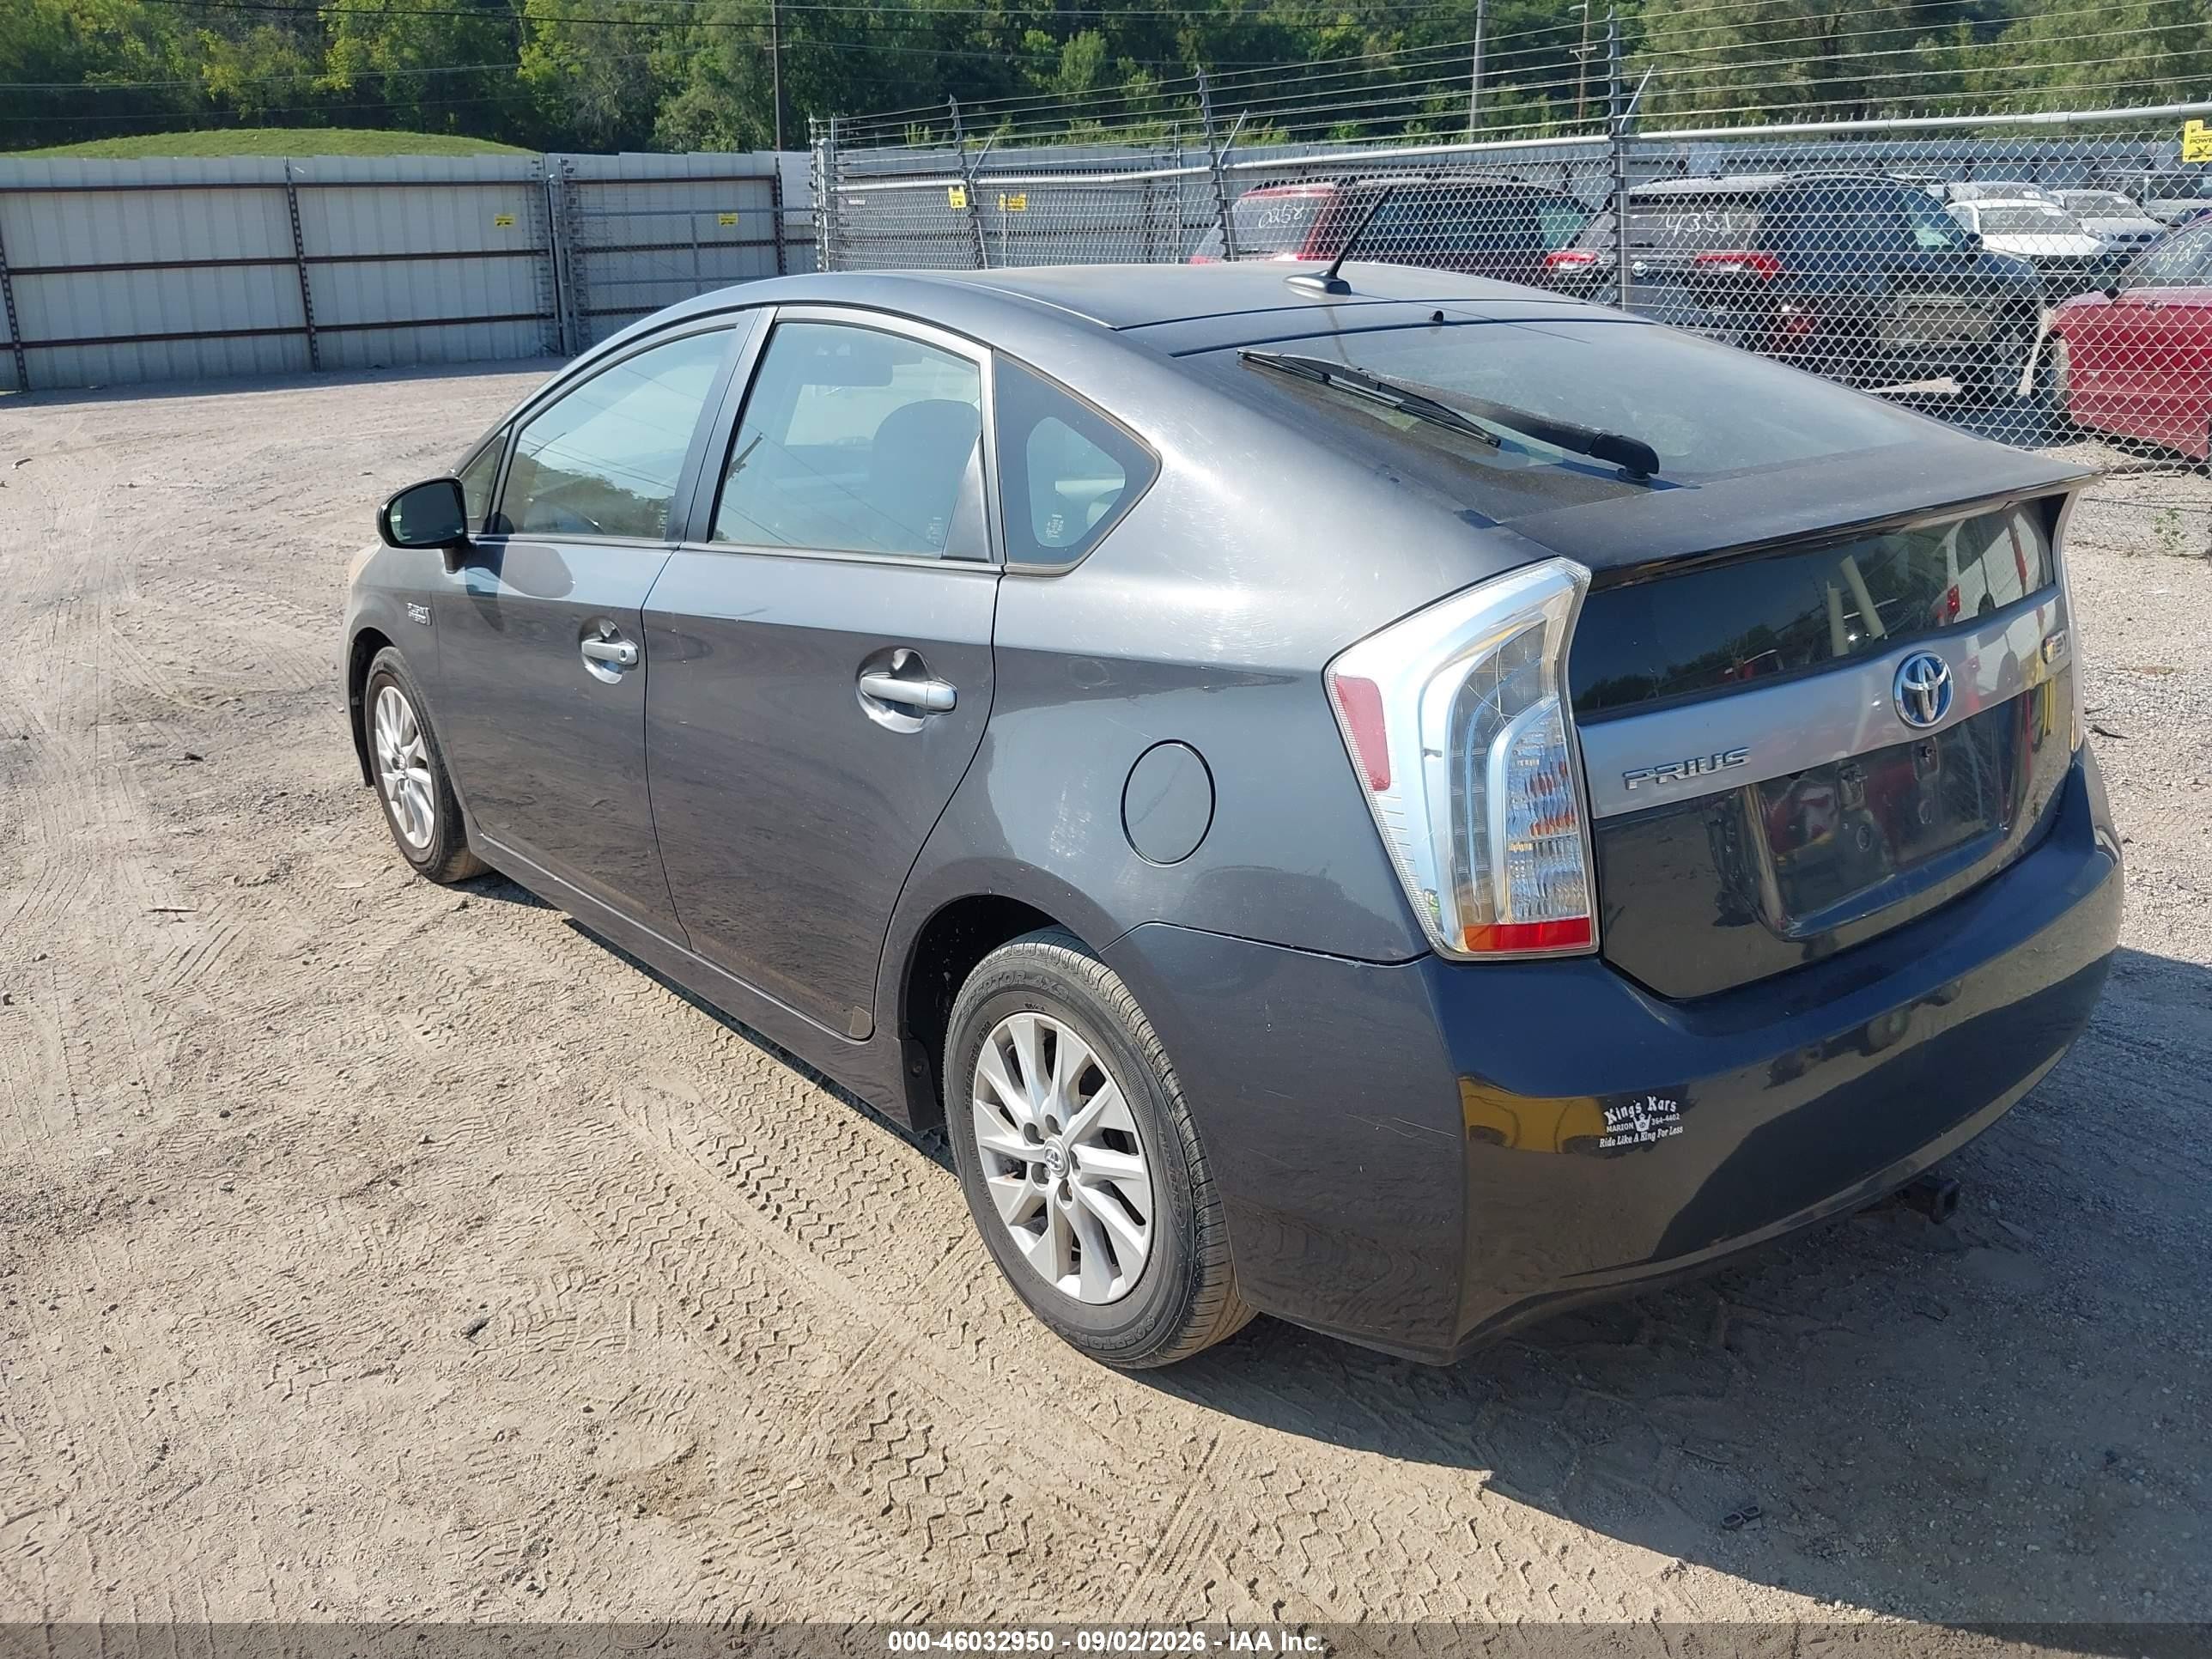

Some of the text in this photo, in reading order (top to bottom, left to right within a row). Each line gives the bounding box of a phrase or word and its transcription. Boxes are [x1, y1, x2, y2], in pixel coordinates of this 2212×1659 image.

[1622, 746, 1752, 790] PRIUS
[1647, 1096, 1677, 1112] Kars
[1599, 1126, 1684, 1148] Ride Like A King For Less
